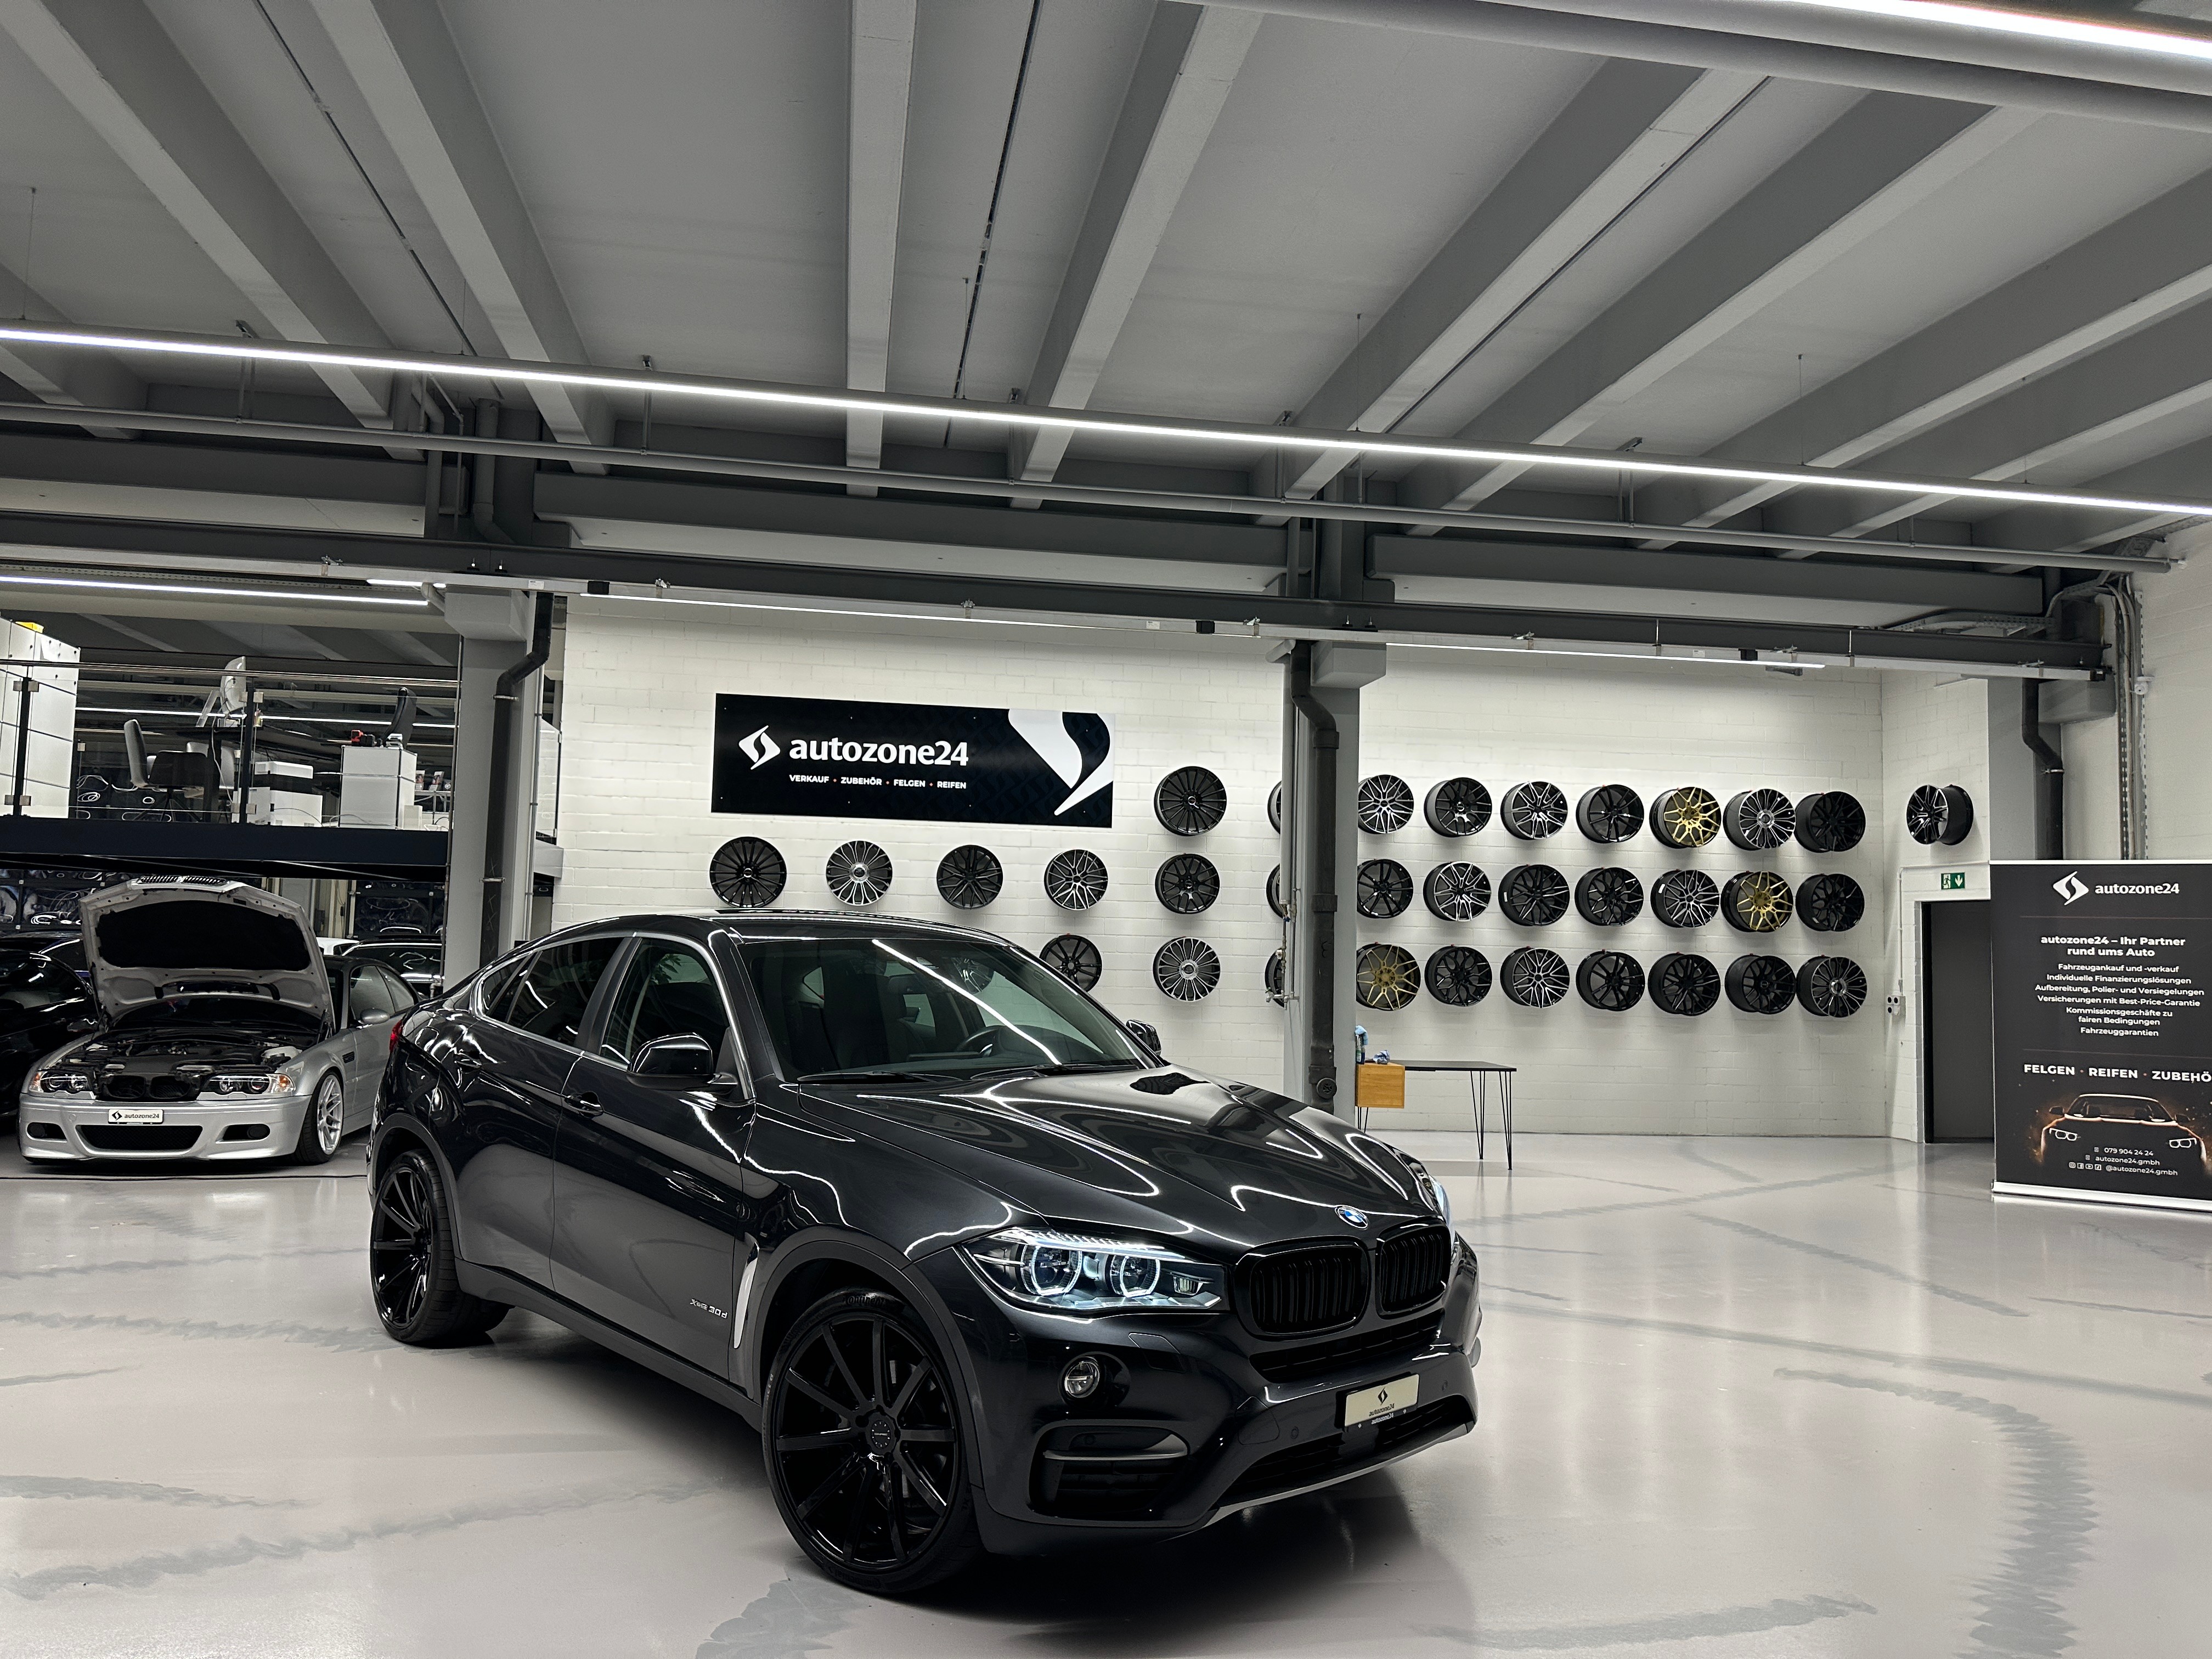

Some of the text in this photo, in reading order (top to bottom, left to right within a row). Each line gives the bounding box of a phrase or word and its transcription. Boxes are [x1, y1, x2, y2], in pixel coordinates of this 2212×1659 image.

[789, 737, 969, 766] autozone24
[789, 774, 967, 789] VERKAUF ZUBEHÖR FELGEN REIFEN
[2095, 883, 2180, 894] autozone24
[2041, 935, 2109, 945] autozone24
[2120, 936, 2137, 945] Ihr
[2140, 937, 2186, 946] Partner
[2067, 947, 2095, 955] rund
[2126, 948, 2155, 957] Auto
[2058, 963, 2125, 972] Fahrzeugankauf
[2095, 975, 2192, 985] Finanzierungslösungen
[2035, 984, 2091, 994] Aufbereitung,
[2138, 988, 2205, 996] Versiegelungen
[2037, 995, 2102, 1005] Versicherungen
[2119, 998, 2200, 1007] Best-Price-Garantie
[2066, 1007, 2161, 1017] Kommissionsgeschäfte
[2104, 1017, 2160, 1026] Bedingungen
[2080, 1027, 2159, 1036] Fahrzeuggarantien
[2024, 1064, 2075, 1075] FELGEN
[2089, 1068, 2138, 1079] REIFEN
